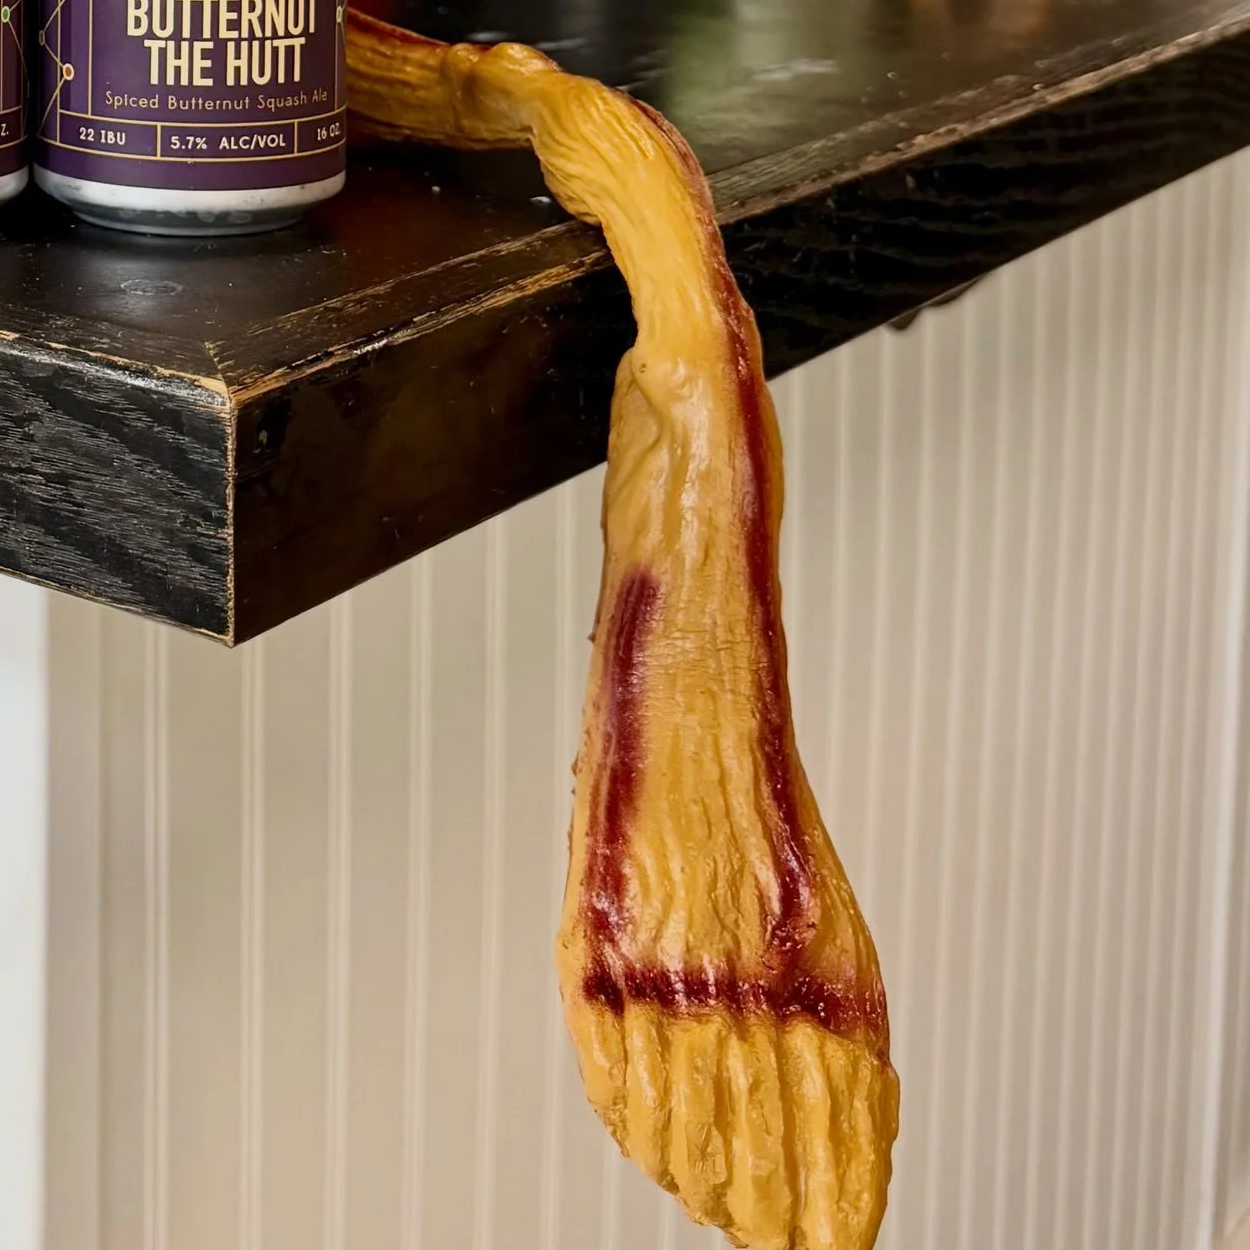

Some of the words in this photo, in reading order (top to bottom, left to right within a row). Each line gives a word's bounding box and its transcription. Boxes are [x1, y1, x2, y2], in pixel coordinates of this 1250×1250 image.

[143, 39, 214, 86] THE
[226, 37, 306, 87] HUTT
[105, 90, 159, 110] Spiced
[167, 95, 250, 111] Butternut
[256, 91, 307, 113] Squash
[311, 87, 328, 103] Ale
[79, 126, 95, 142] 22
[100, 129, 126, 146] IBU
[170, 135, 208, 150] 5.7%
[218, 133, 286, 150] ALC/VOL
[317, 126, 328, 141] 16
